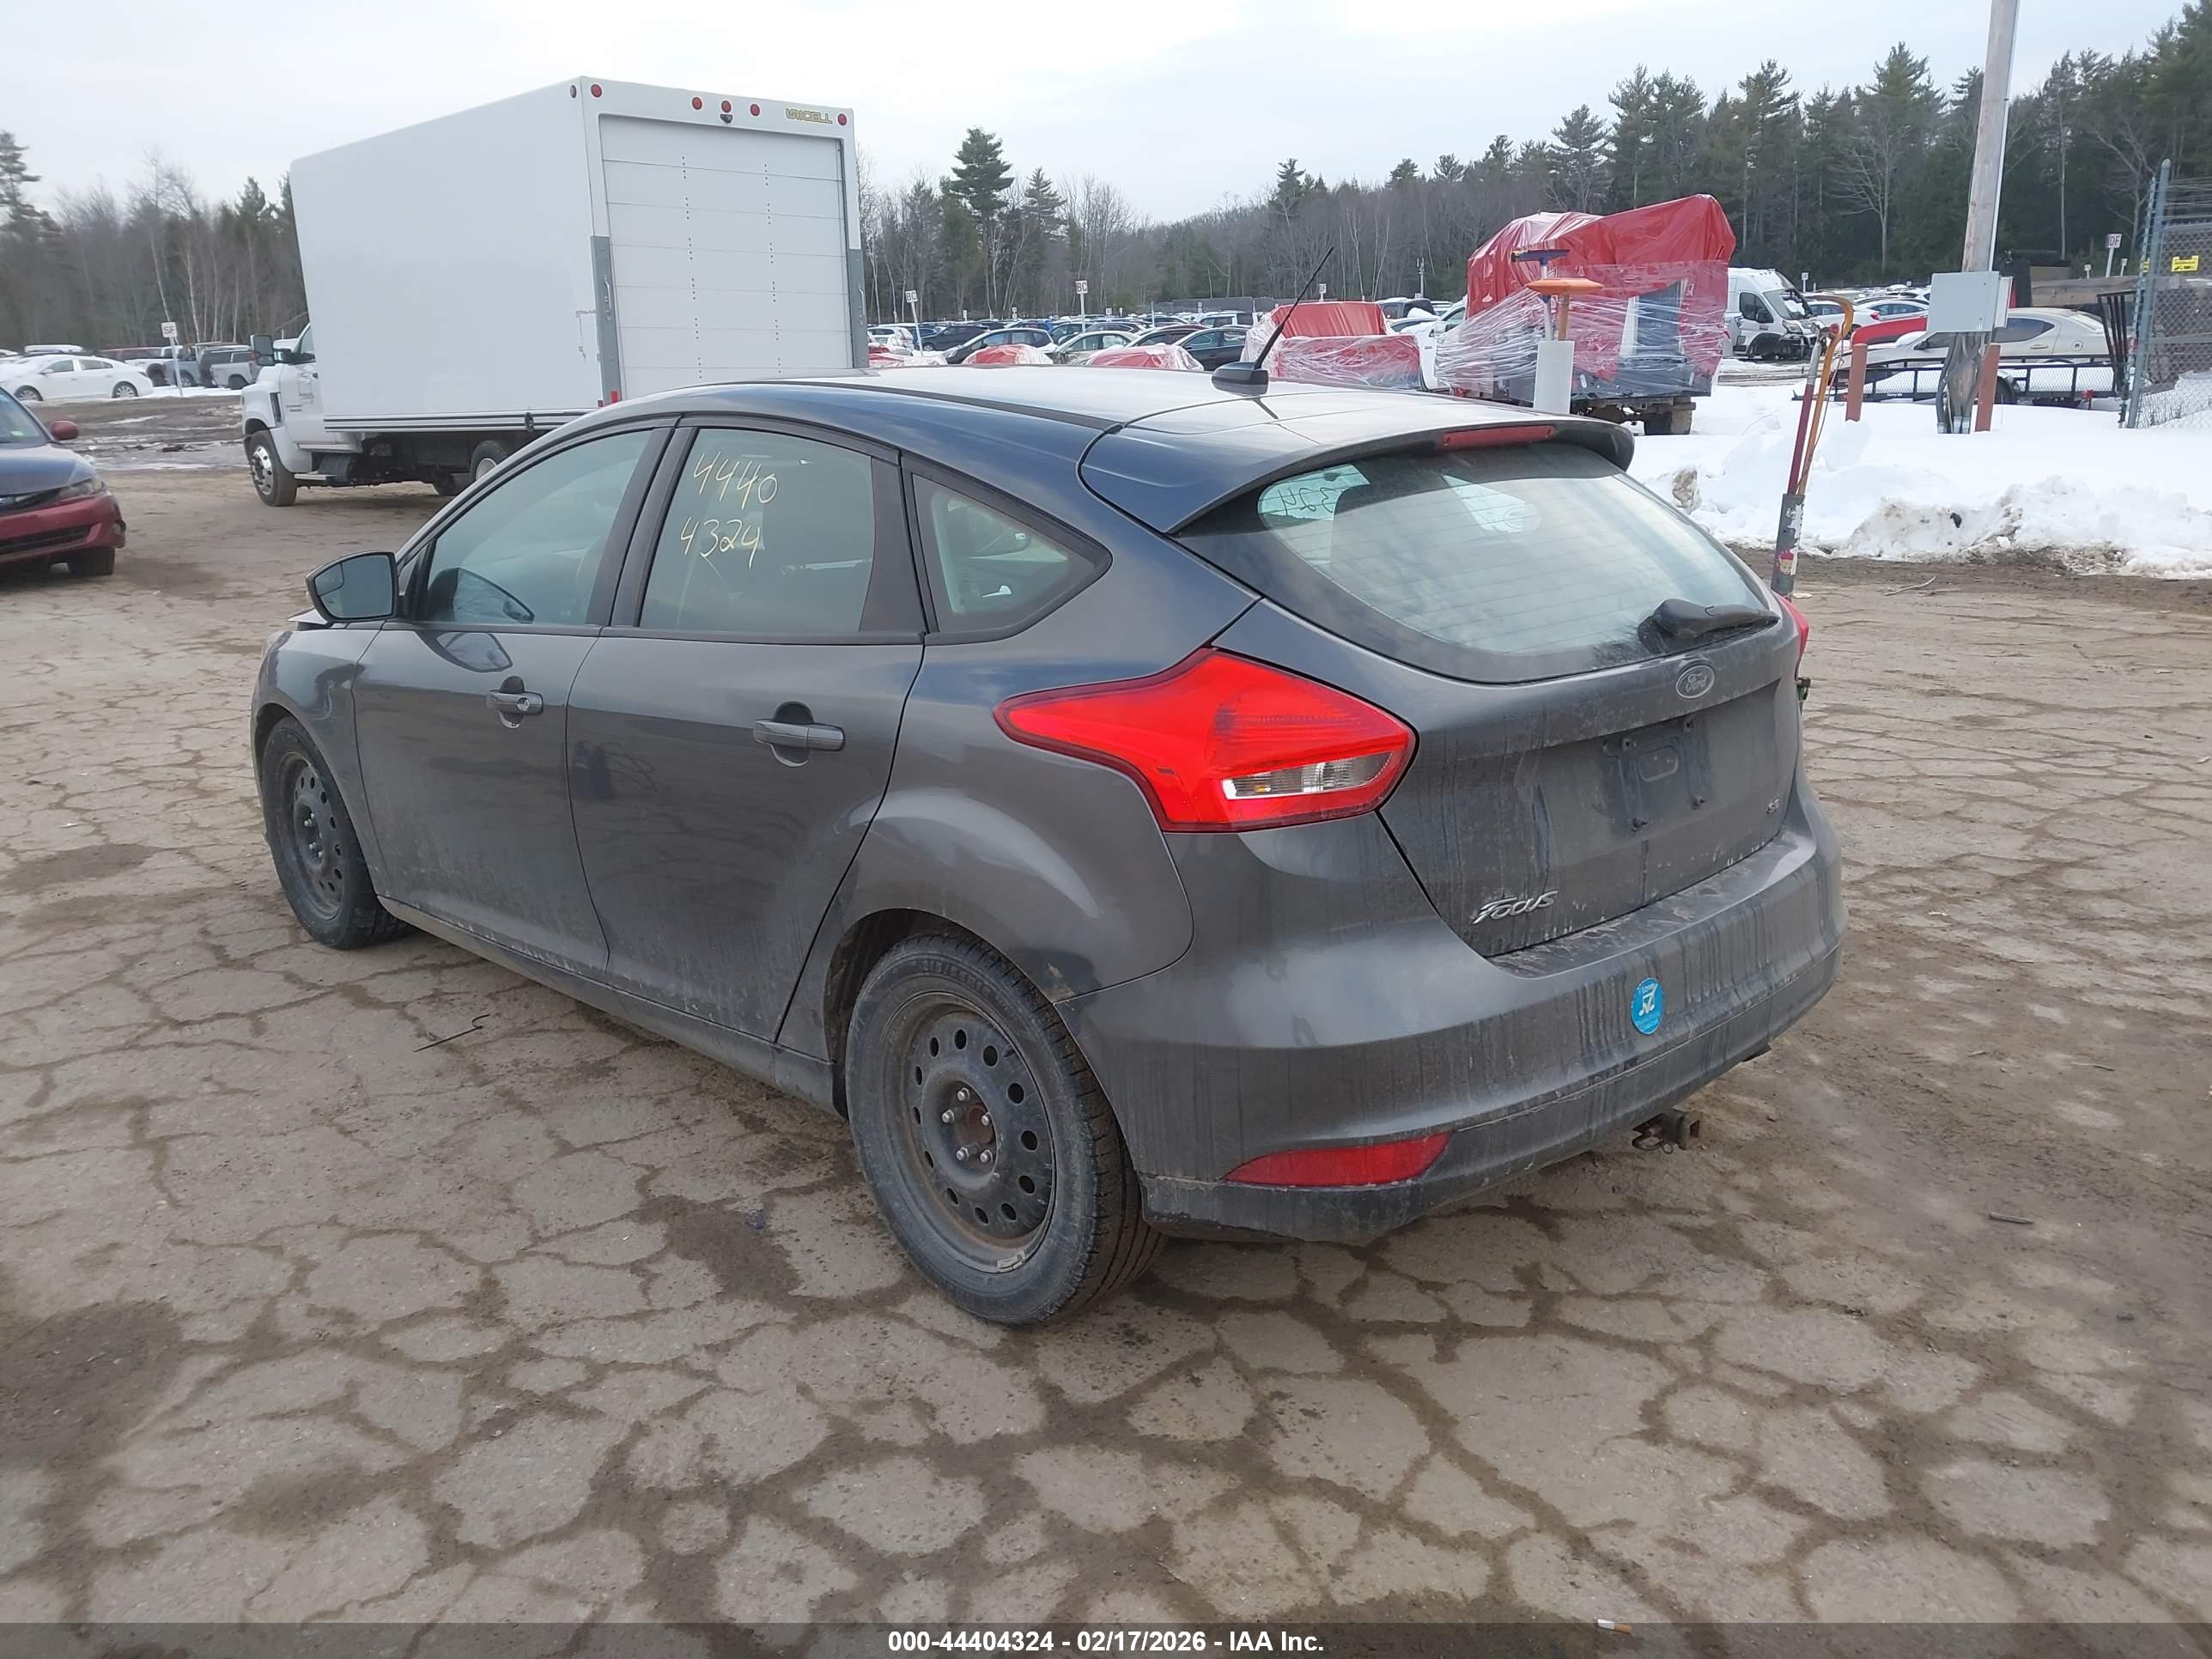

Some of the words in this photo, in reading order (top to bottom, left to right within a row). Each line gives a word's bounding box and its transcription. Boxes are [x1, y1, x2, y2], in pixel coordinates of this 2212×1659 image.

[906, 291, 917, 301] BC
[1076, 282, 1087, 292] BC
[693, 452, 778, 510] 4440
[680, 516, 761, 569] 4324
